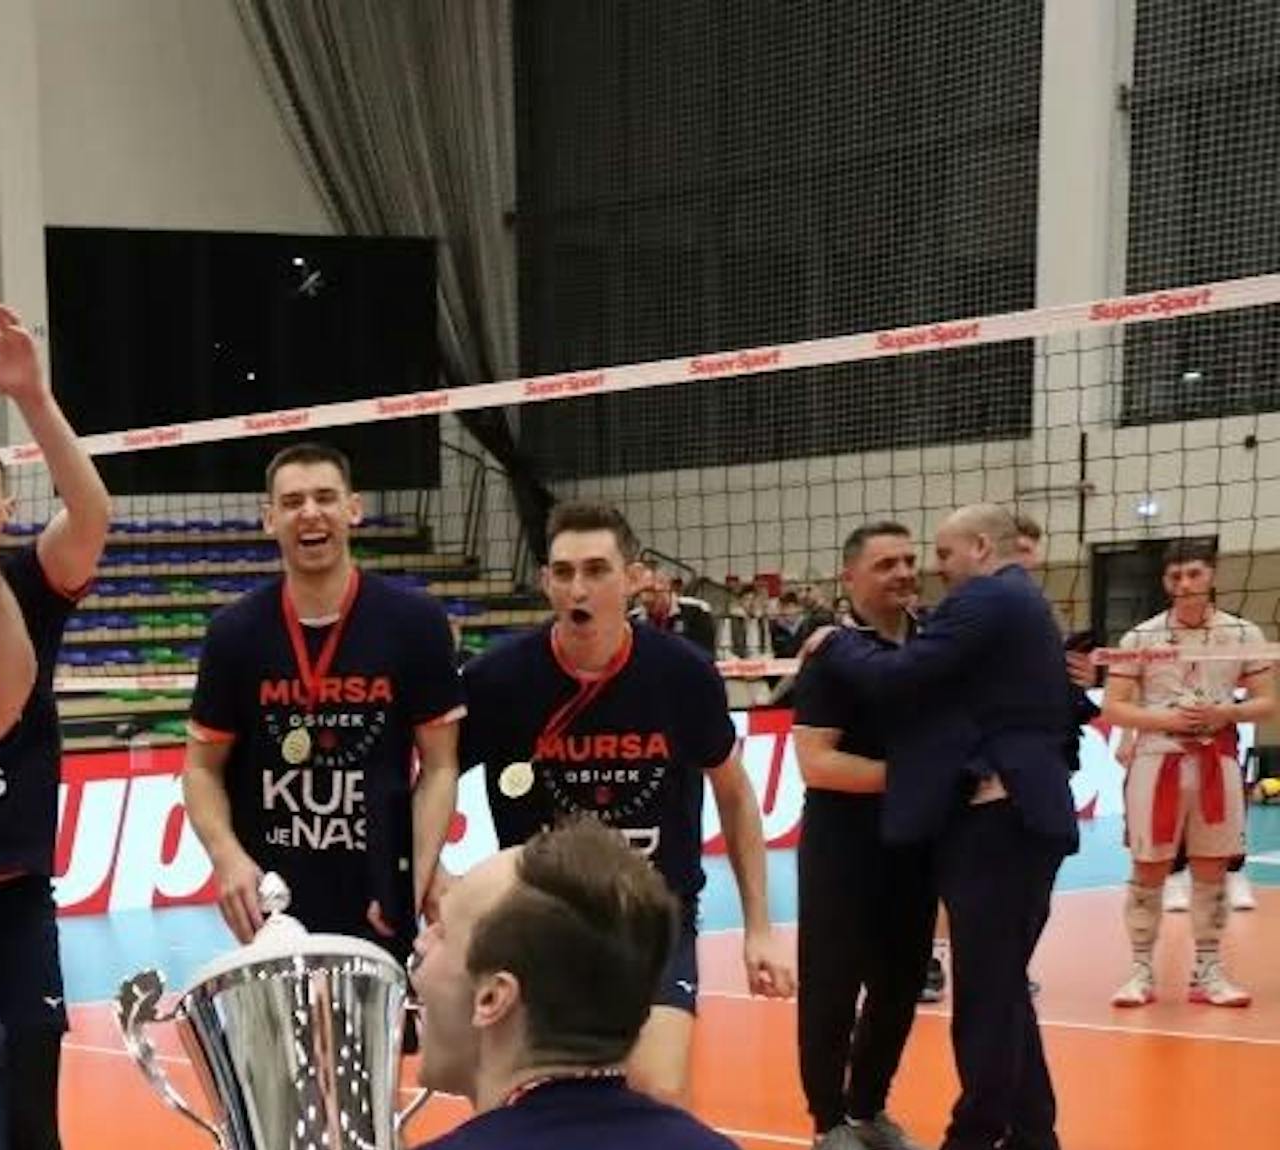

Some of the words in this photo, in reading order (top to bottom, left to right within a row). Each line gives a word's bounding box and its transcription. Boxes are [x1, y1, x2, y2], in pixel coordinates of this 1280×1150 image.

[874, 322, 981, 351] SuperSport
[1088, 288, 1214, 321] SuperSport
[535, 732, 670, 762] MURSA
